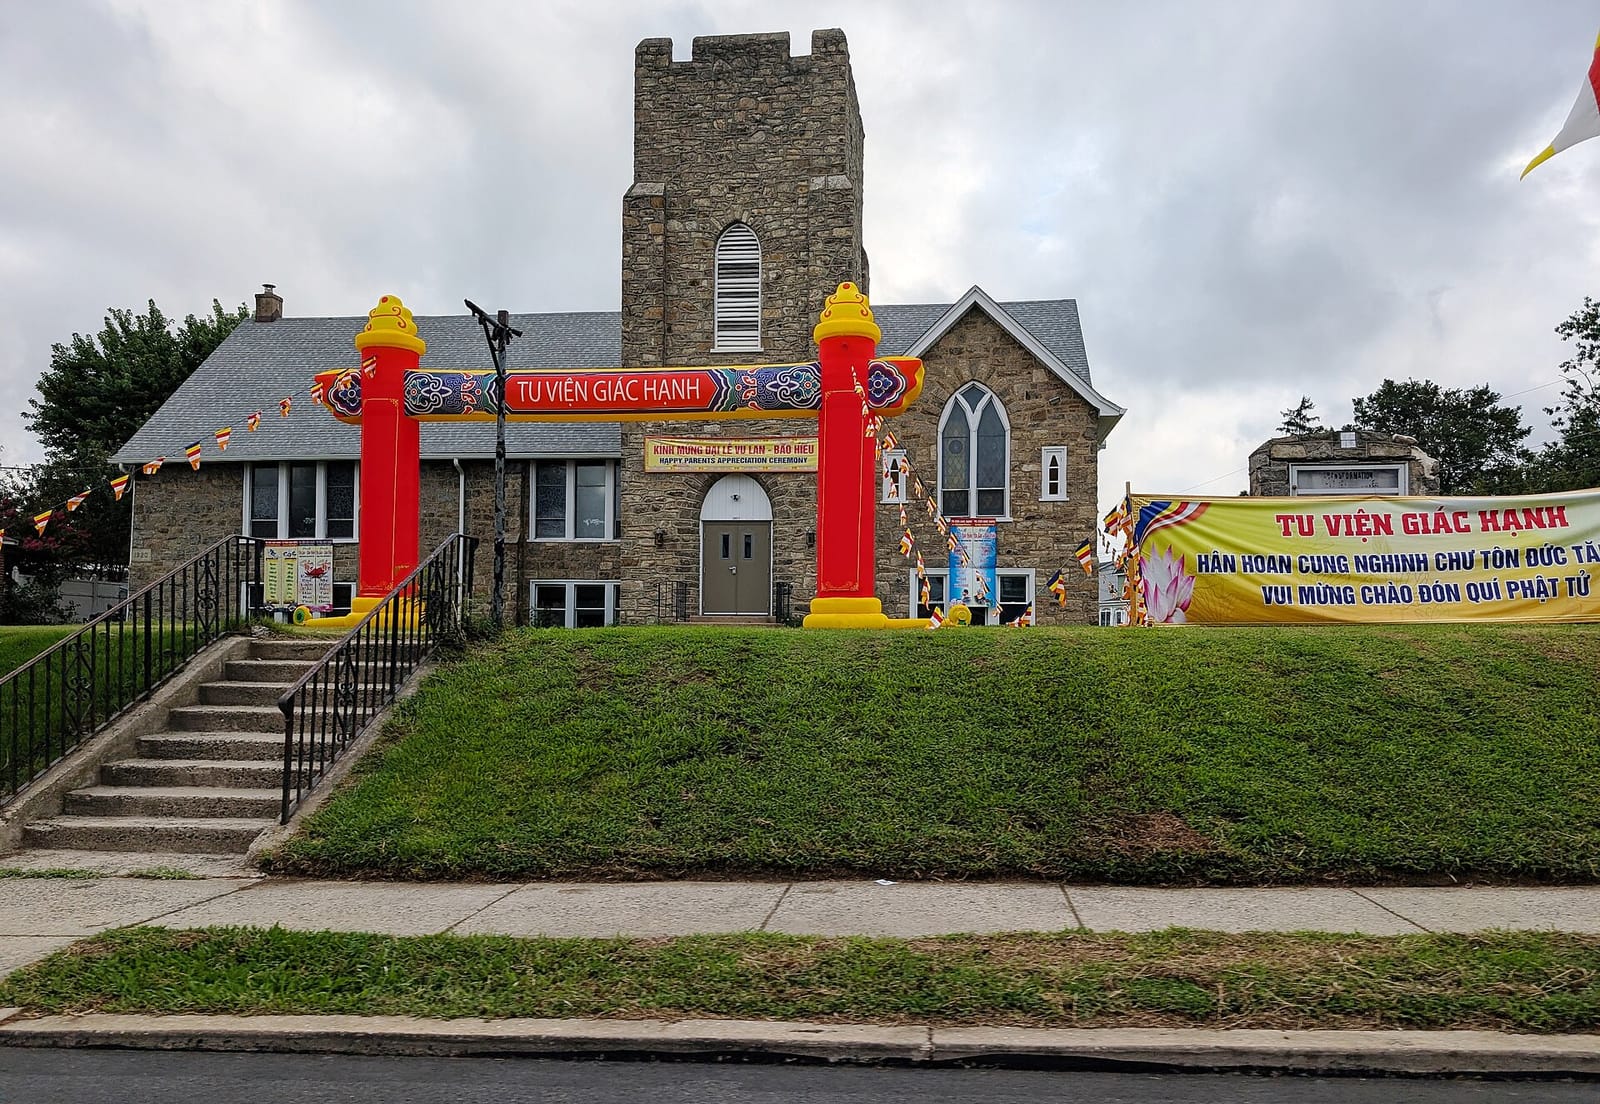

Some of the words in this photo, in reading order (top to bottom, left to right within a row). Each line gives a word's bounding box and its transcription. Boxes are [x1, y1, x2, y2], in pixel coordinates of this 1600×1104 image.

[517, 380, 542, 402] TU
[546, 377, 587, 407] VIỆN
[593, 376, 639, 402] GIÁC
[644, 378, 700, 405] HẠNH
[1275, 514, 1315, 537] TU
[1323, 508, 1394, 543] VIỆN
[1402, 505, 1471, 535] GIÁC
[1478, 505, 1569, 537] HẠNH
[1197, 550, 1235, 573] HÂN
[1242, 554, 1292, 573] HOAN
[1299, 555, 1349, 573] CUNG
[1354, 553, 1428, 573] NGHINH
[1435, 548, 1475, 571] CHƯ
[1480, 546, 1520, 570] TÔN
[1525, 543, 1568, 567] ĐỨC
[1571, 541, 1600, 563] TĂ
[1262, 585, 1292, 605] VUI
[1298, 581, 1355, 605] MỪNG
[1360, 581, 1413, 604] CHÀO
[1418, 580, 1460, 603] ĐÓN
[1466, 577, 1502, 603] QUÍ
[1506, 575, 1559, 603] PHẬT
[1565, 570, 1591, 596] TỬ
